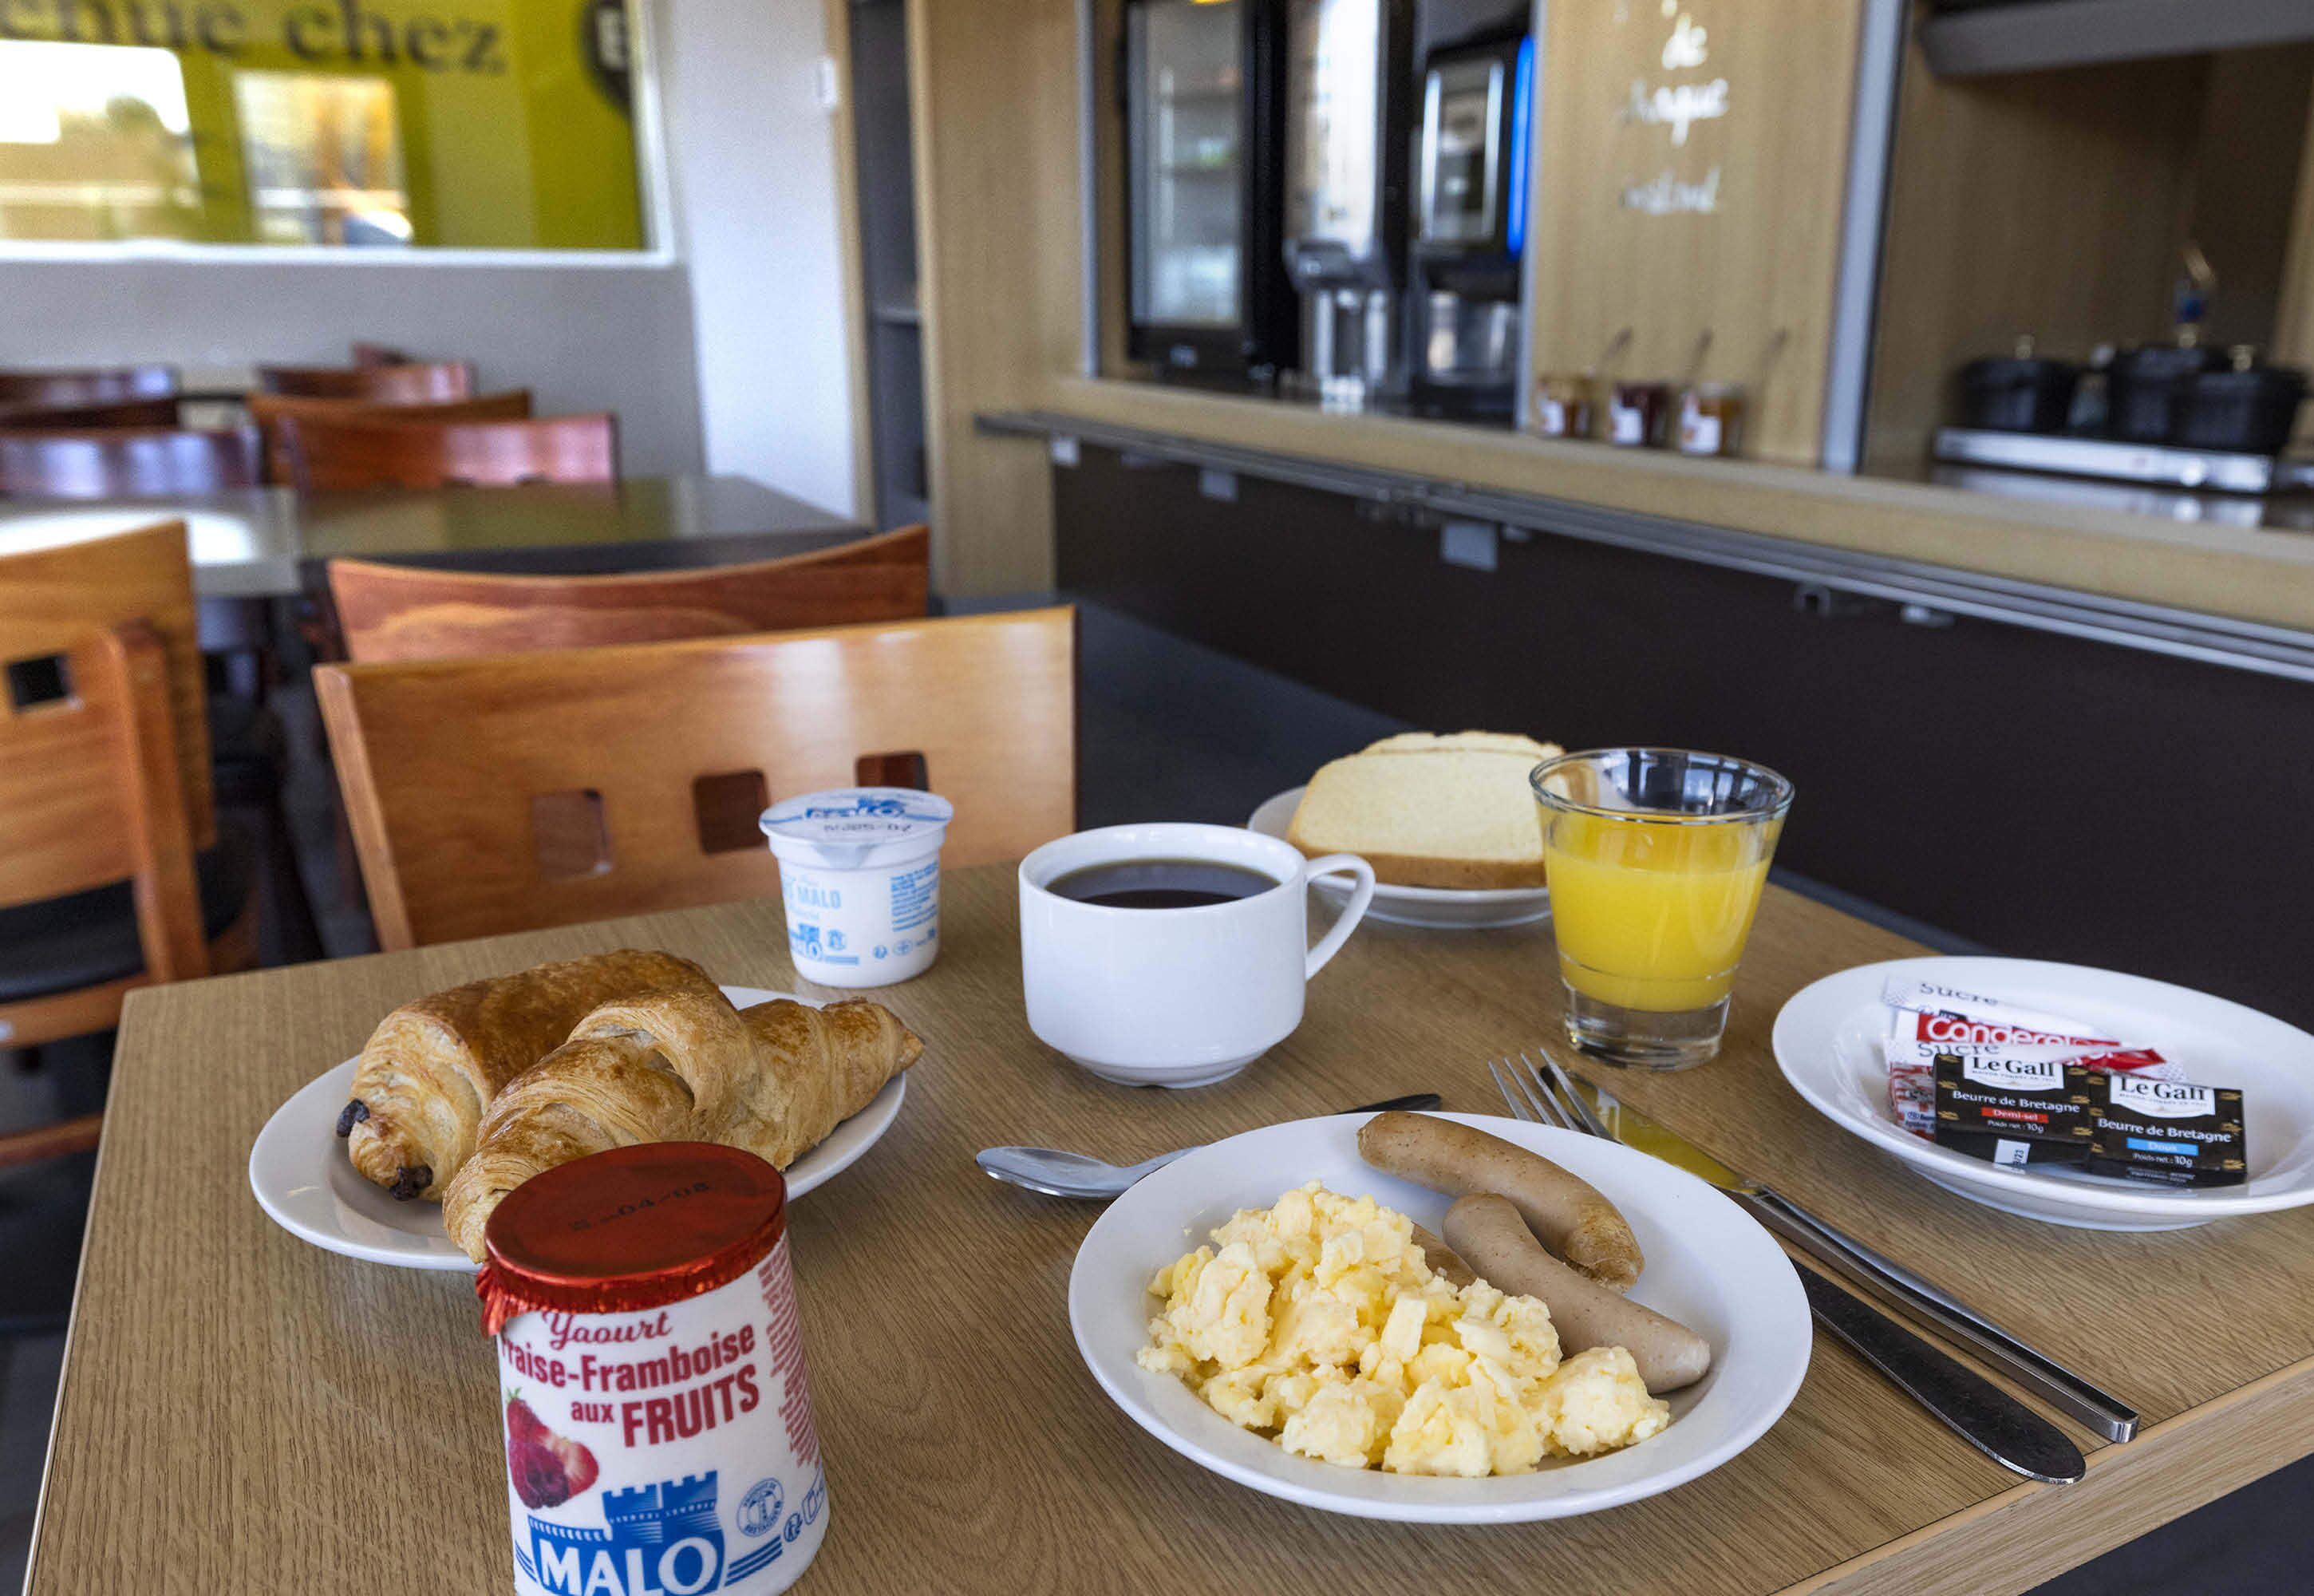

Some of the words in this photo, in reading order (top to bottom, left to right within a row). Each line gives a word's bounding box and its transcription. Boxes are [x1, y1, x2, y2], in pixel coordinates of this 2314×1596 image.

[282, 0, 509, 75] chez
[1920, 982, 1999, 1006] Sucre
[1917, 1041, 2001, 1057] Sucre
[1972, 1057, 2001, 1073] Le
[2004, 1059, 2055, 1077] Gall
[2119, 1077, 2150, 1093] Le
[2154, 1082, 2206, 1101] Gall
[1952, 1090, 1997, 1105] Beurre
[1998, 1096, 2016, 1108] de
[2018, 1097, 2081, 1114] Bretagne
[2026, 1122, 2044, 1134] 10g
[2097, 1117, 2145, 1135] Beurre
[2145, 1124, 2165, 1137] de
[2166, 1126, 2233, 1144] Bretagne
[2174, 1156, 2194, 1168] 10g
[541, 1311, 673, 1351] Yaourt
[571, 1400, 615, 1424] aux
[622, 1364, 760, 1448] FRUITS
[539, 1537, 718, 1596] MALO
